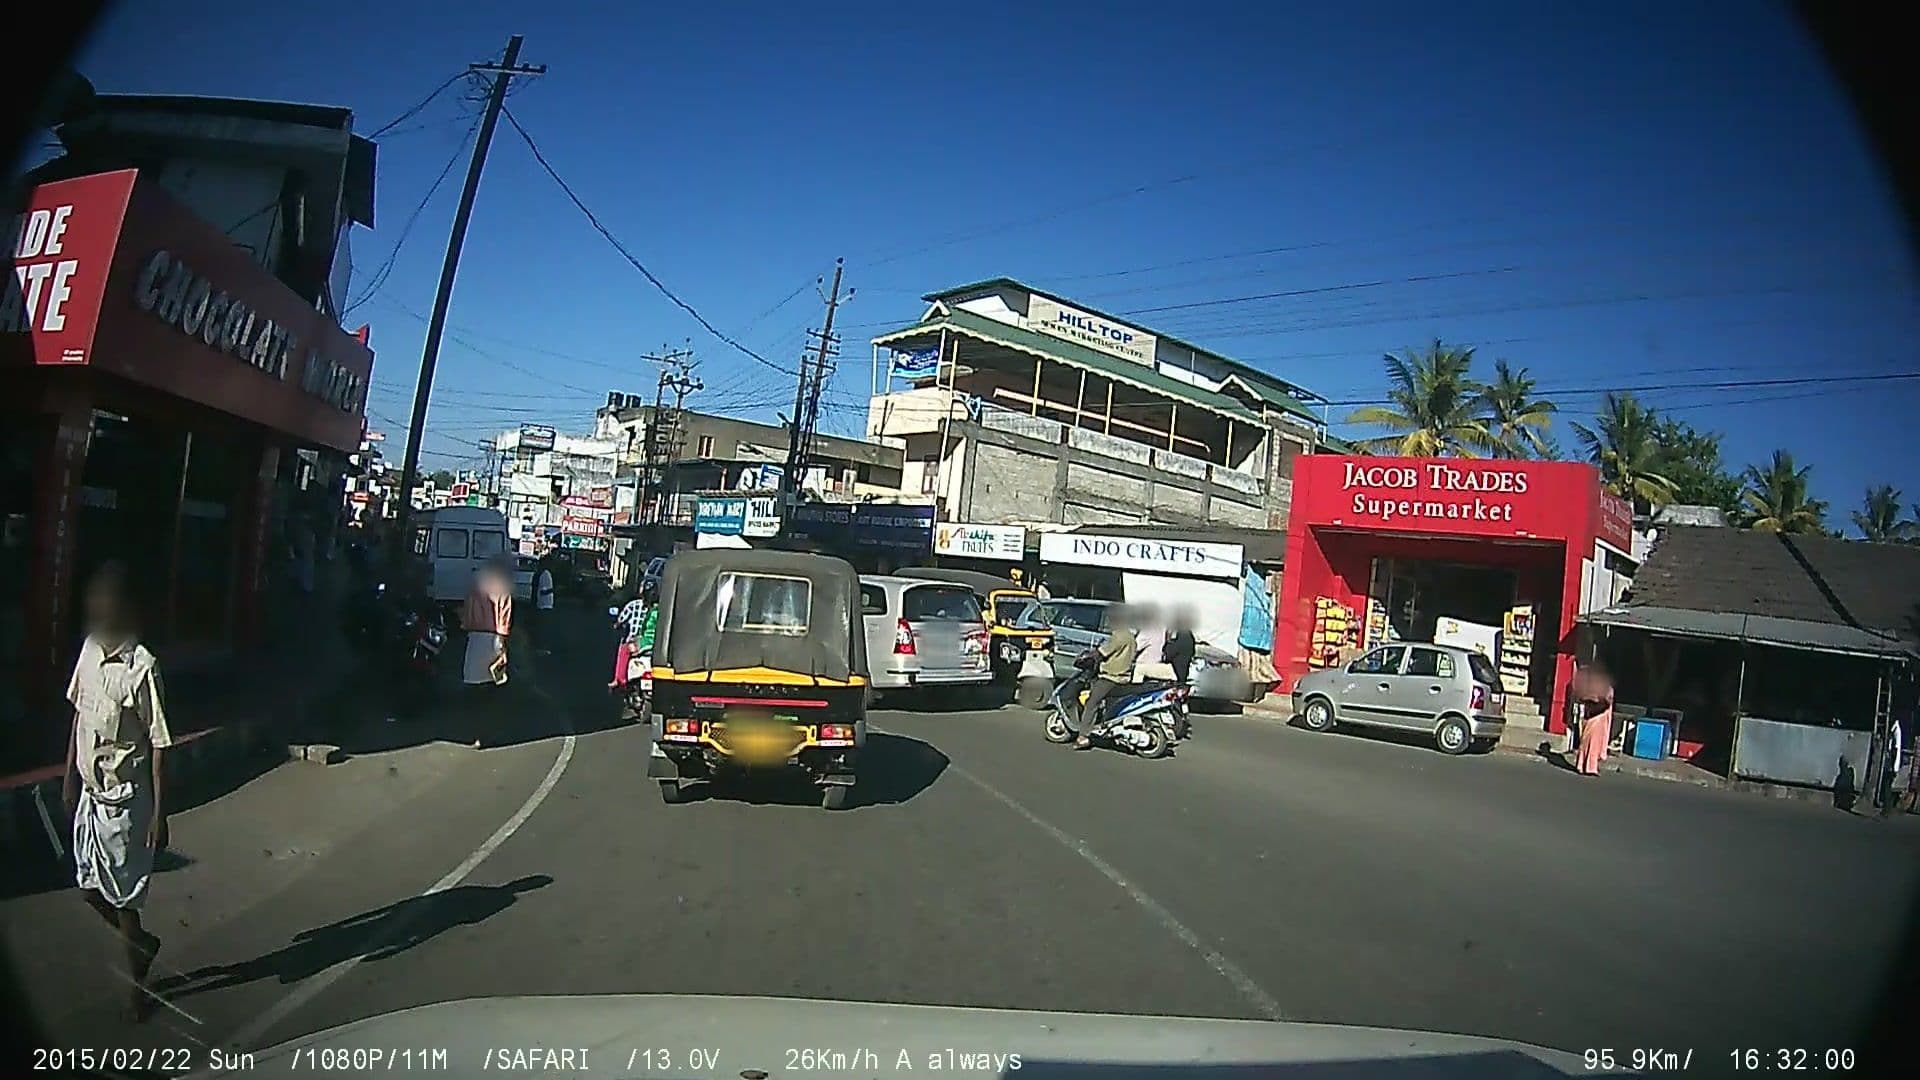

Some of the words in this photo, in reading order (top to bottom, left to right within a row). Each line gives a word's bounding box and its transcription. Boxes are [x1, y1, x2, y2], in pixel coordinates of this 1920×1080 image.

[1343, 462, 1417, 490] JACOB
[1426, 464, 1527, 493] TRADES
[1352, 493, 1512, 521] Supermarket
[1073, 539, 1120, 556] INDO
[1126, 542, 1206, 563] CRAFTS
